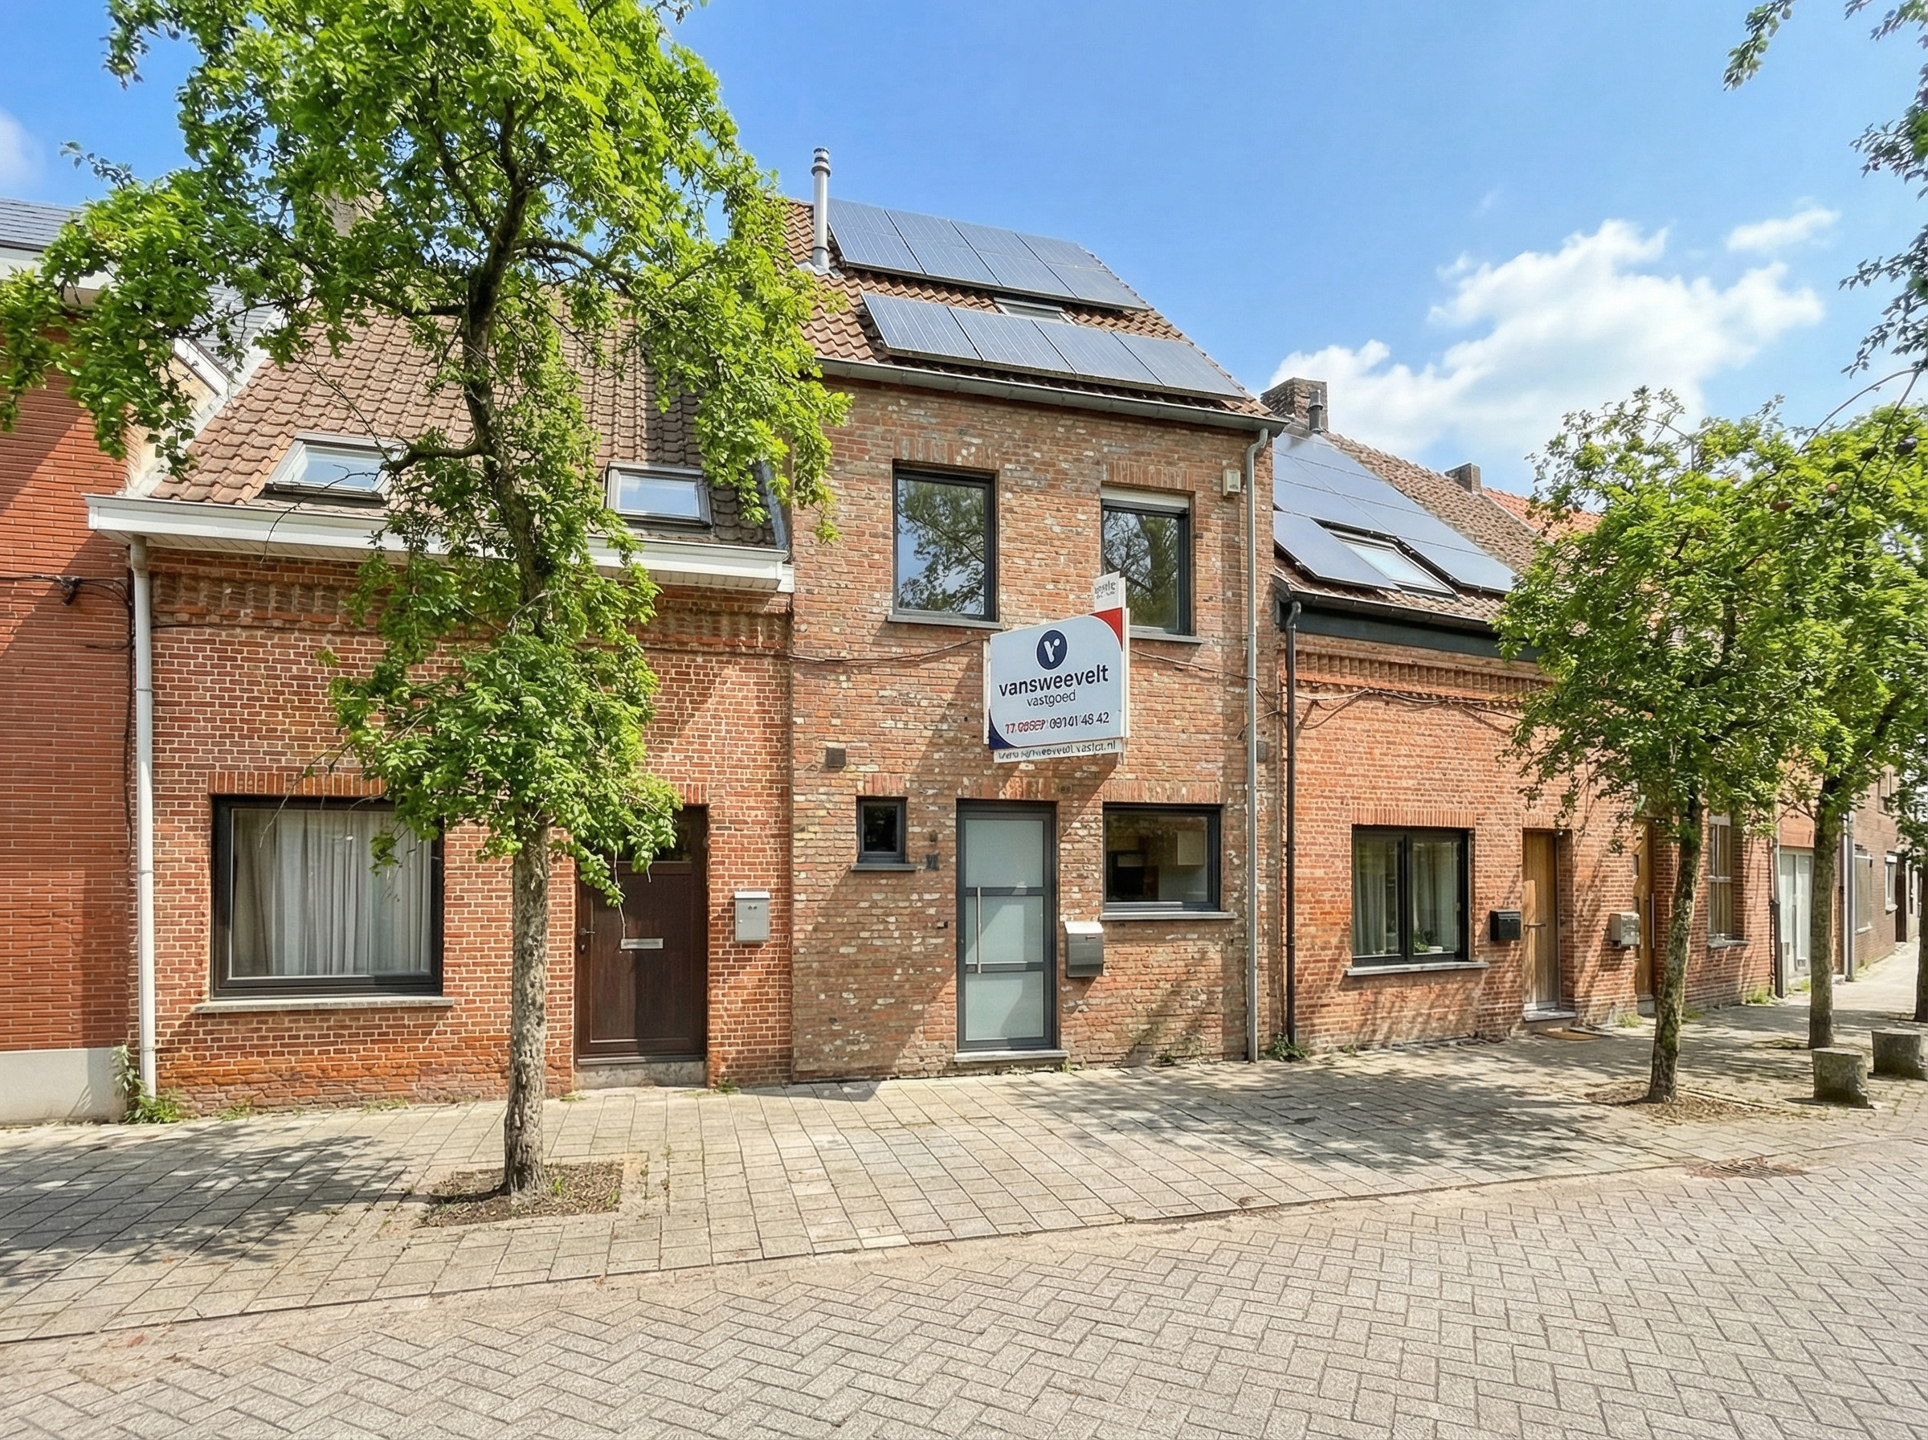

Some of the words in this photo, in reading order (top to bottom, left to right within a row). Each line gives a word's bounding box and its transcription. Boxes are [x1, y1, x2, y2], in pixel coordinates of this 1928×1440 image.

[998, 664, 1109, 697] vansweevelt
[1026, 689, 1076, 708] vastgoed
[1096, 711, 1110, 724] 42
